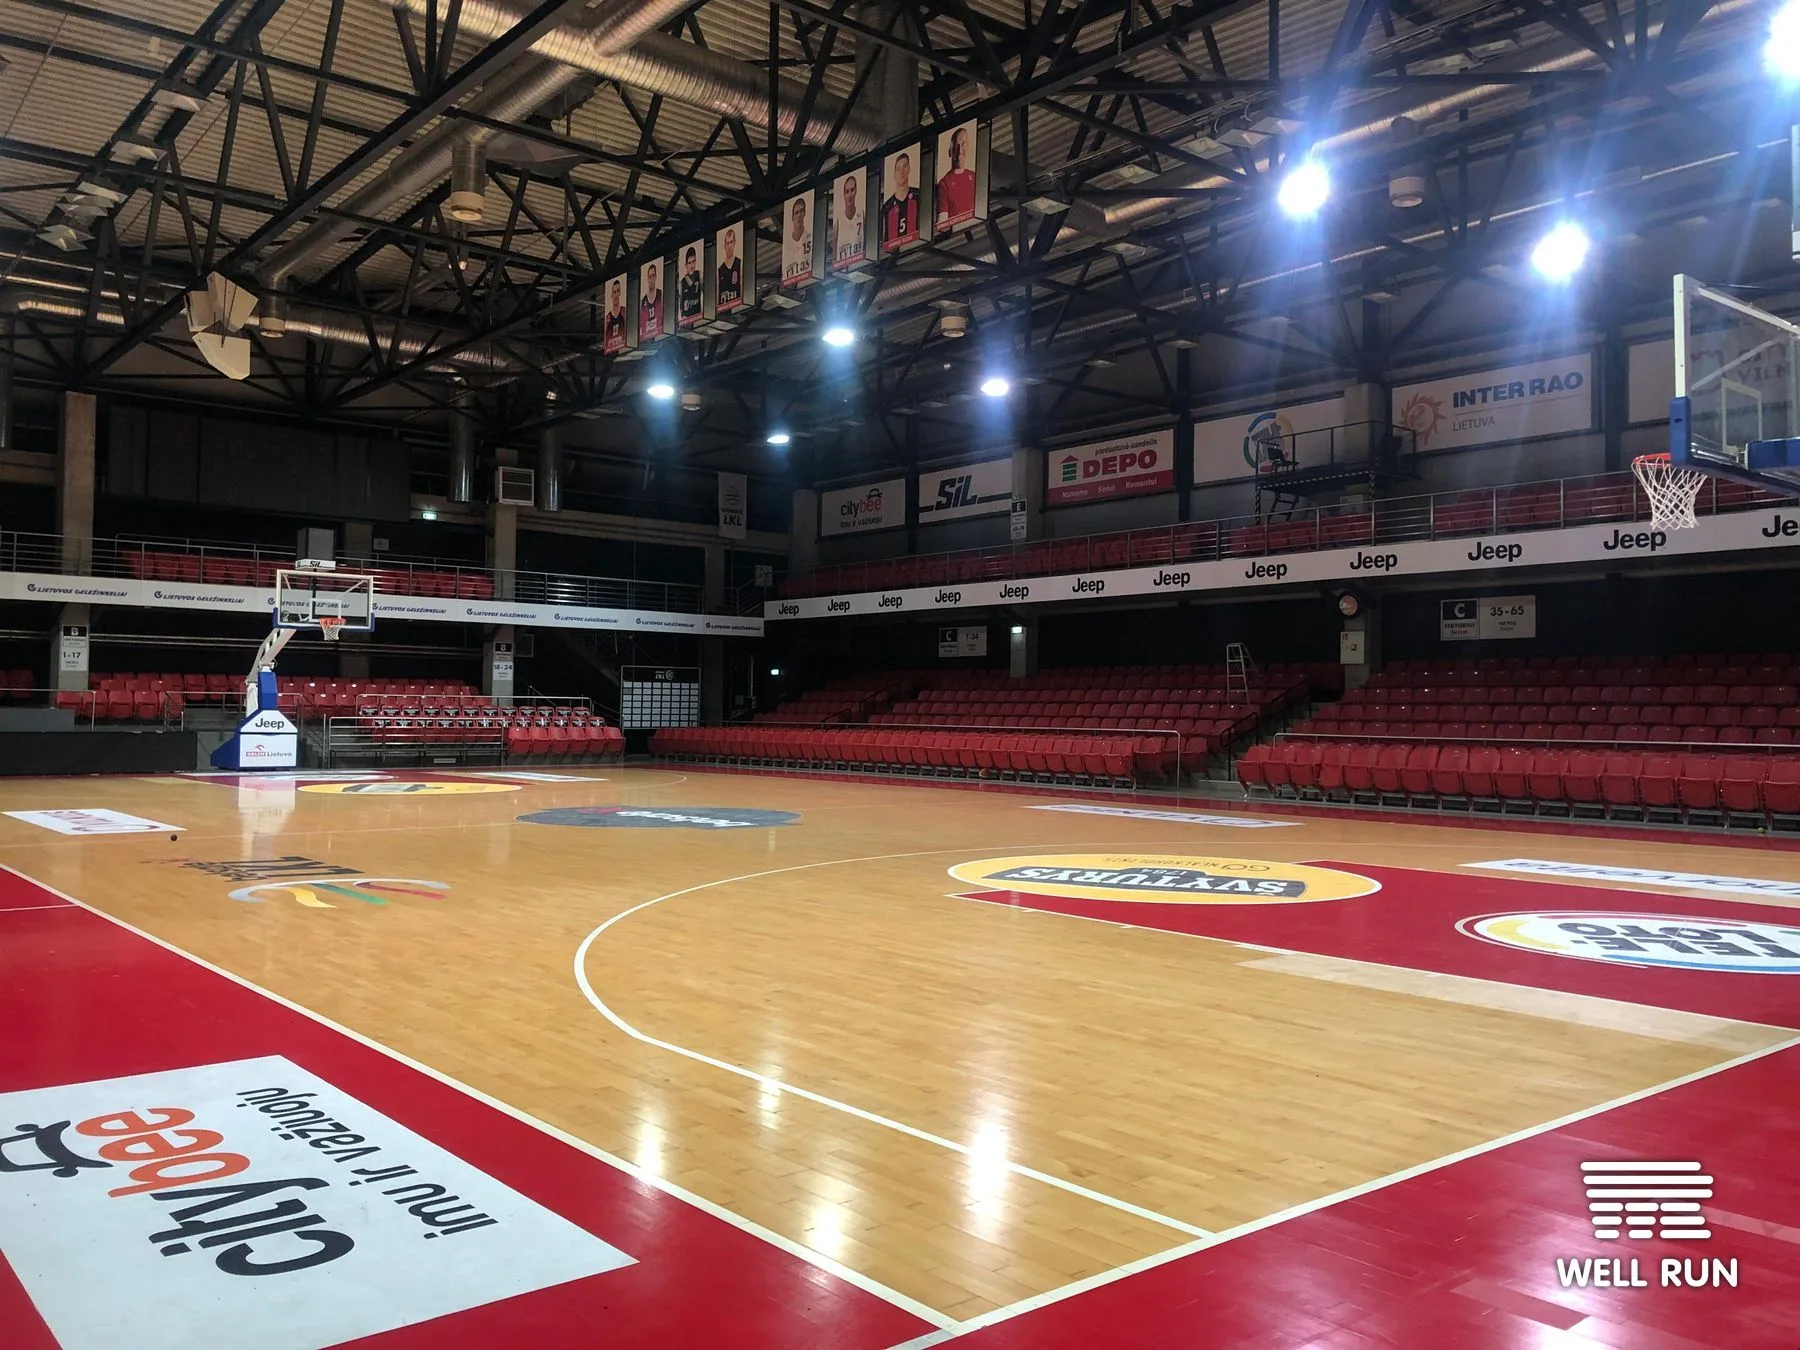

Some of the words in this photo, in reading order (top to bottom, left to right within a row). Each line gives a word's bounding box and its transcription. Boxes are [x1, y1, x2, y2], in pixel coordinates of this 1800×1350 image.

[900, 218, 906, 233] 5
[802, 241, 811, 255] 15
[1452, 380, 1525, 408] INTER
[1528, 371, 1584, 395] RAO
[1453, 416, 1496, 432] LIETUVA
[1083, 449, 1157, 478] DEPO
[841, 499, 882, 517] citybee
[723, 514, 742, 526] LKL
[1603, 529, 1667, 551] Jeep
[1467, 541, 1522, 562] Jeep
[1350, 552, 1398, 571] Jeep
[1245, 561, 1288, 580] Jeep
[1072, 578, 1105, 594] Jeep
[1153, 570, 1191, 588] Jeep
[37, 586, 73, 595] LIETUVOS
[163, 593, 195, 601] LIETUVOS
[935, 589, 961, 604] Jeep
[999, 584, 1029, 600] Jeep
[827, 599, 851, 613] Jeep
[878, 594, 903, 608] Jeep
[778, 603, 800, 616] Jeep
[1454, 603, 1465, 618] C
[946, 630, 953, 641] C
[255, 718, 285, 730] Jeep
[1008, 868, 1288, 896] ŠVYTURYS
[1557, 923, 1779, 944] LOTO
[236, 1087, 382, 1163] važiuoju
[348, 1164, 419, 1186] ir
[75, 1107, 355, 1276] citybee
[382, 1183, 499, 1240] imu
